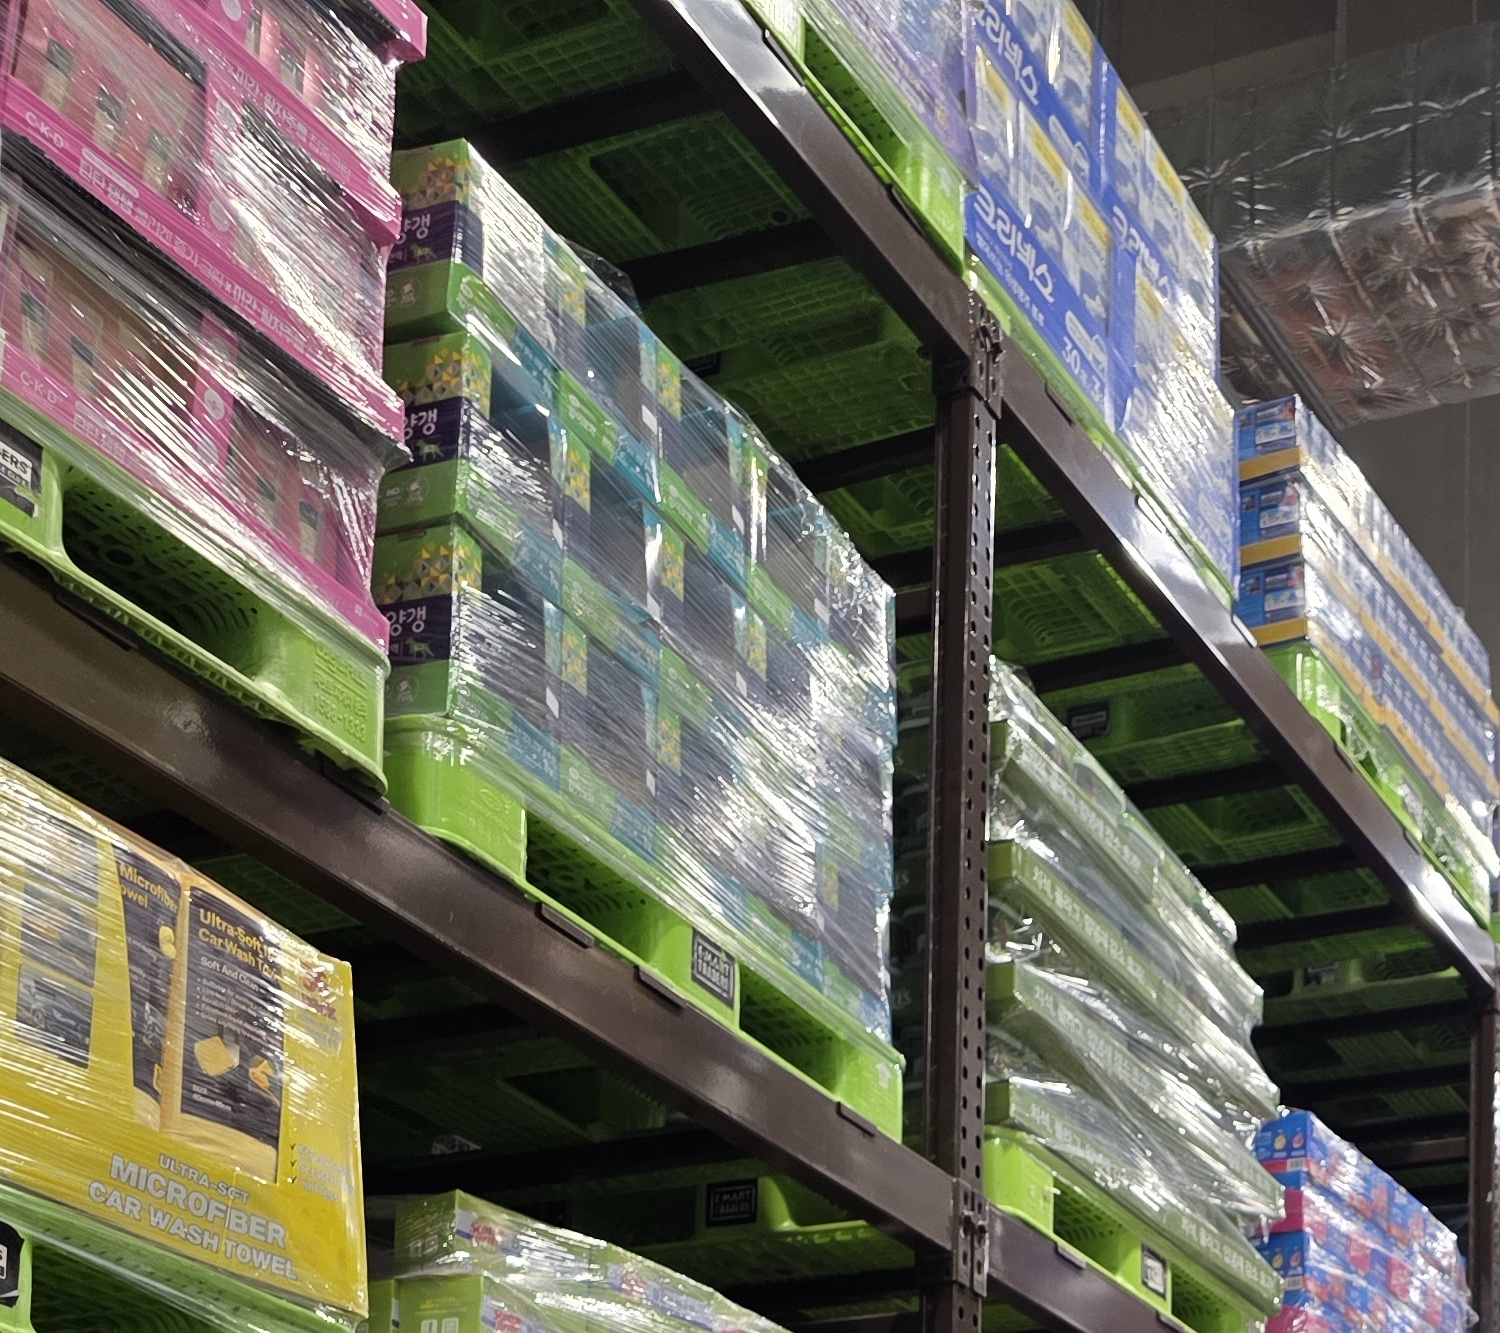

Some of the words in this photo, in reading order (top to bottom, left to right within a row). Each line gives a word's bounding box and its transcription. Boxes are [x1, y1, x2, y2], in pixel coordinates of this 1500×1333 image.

[120, 885, 149, 909] owel
[199, 927, 224, 951] Car
[223, 939, 257, 966] Wash
[89, 1180, 143, 1220] CAR
[149, 1205, 220, 1253] WASH
[223, 1239, 298, 1280] TOWEL
[110, 1153, 287, 1248] MICROFIBER
